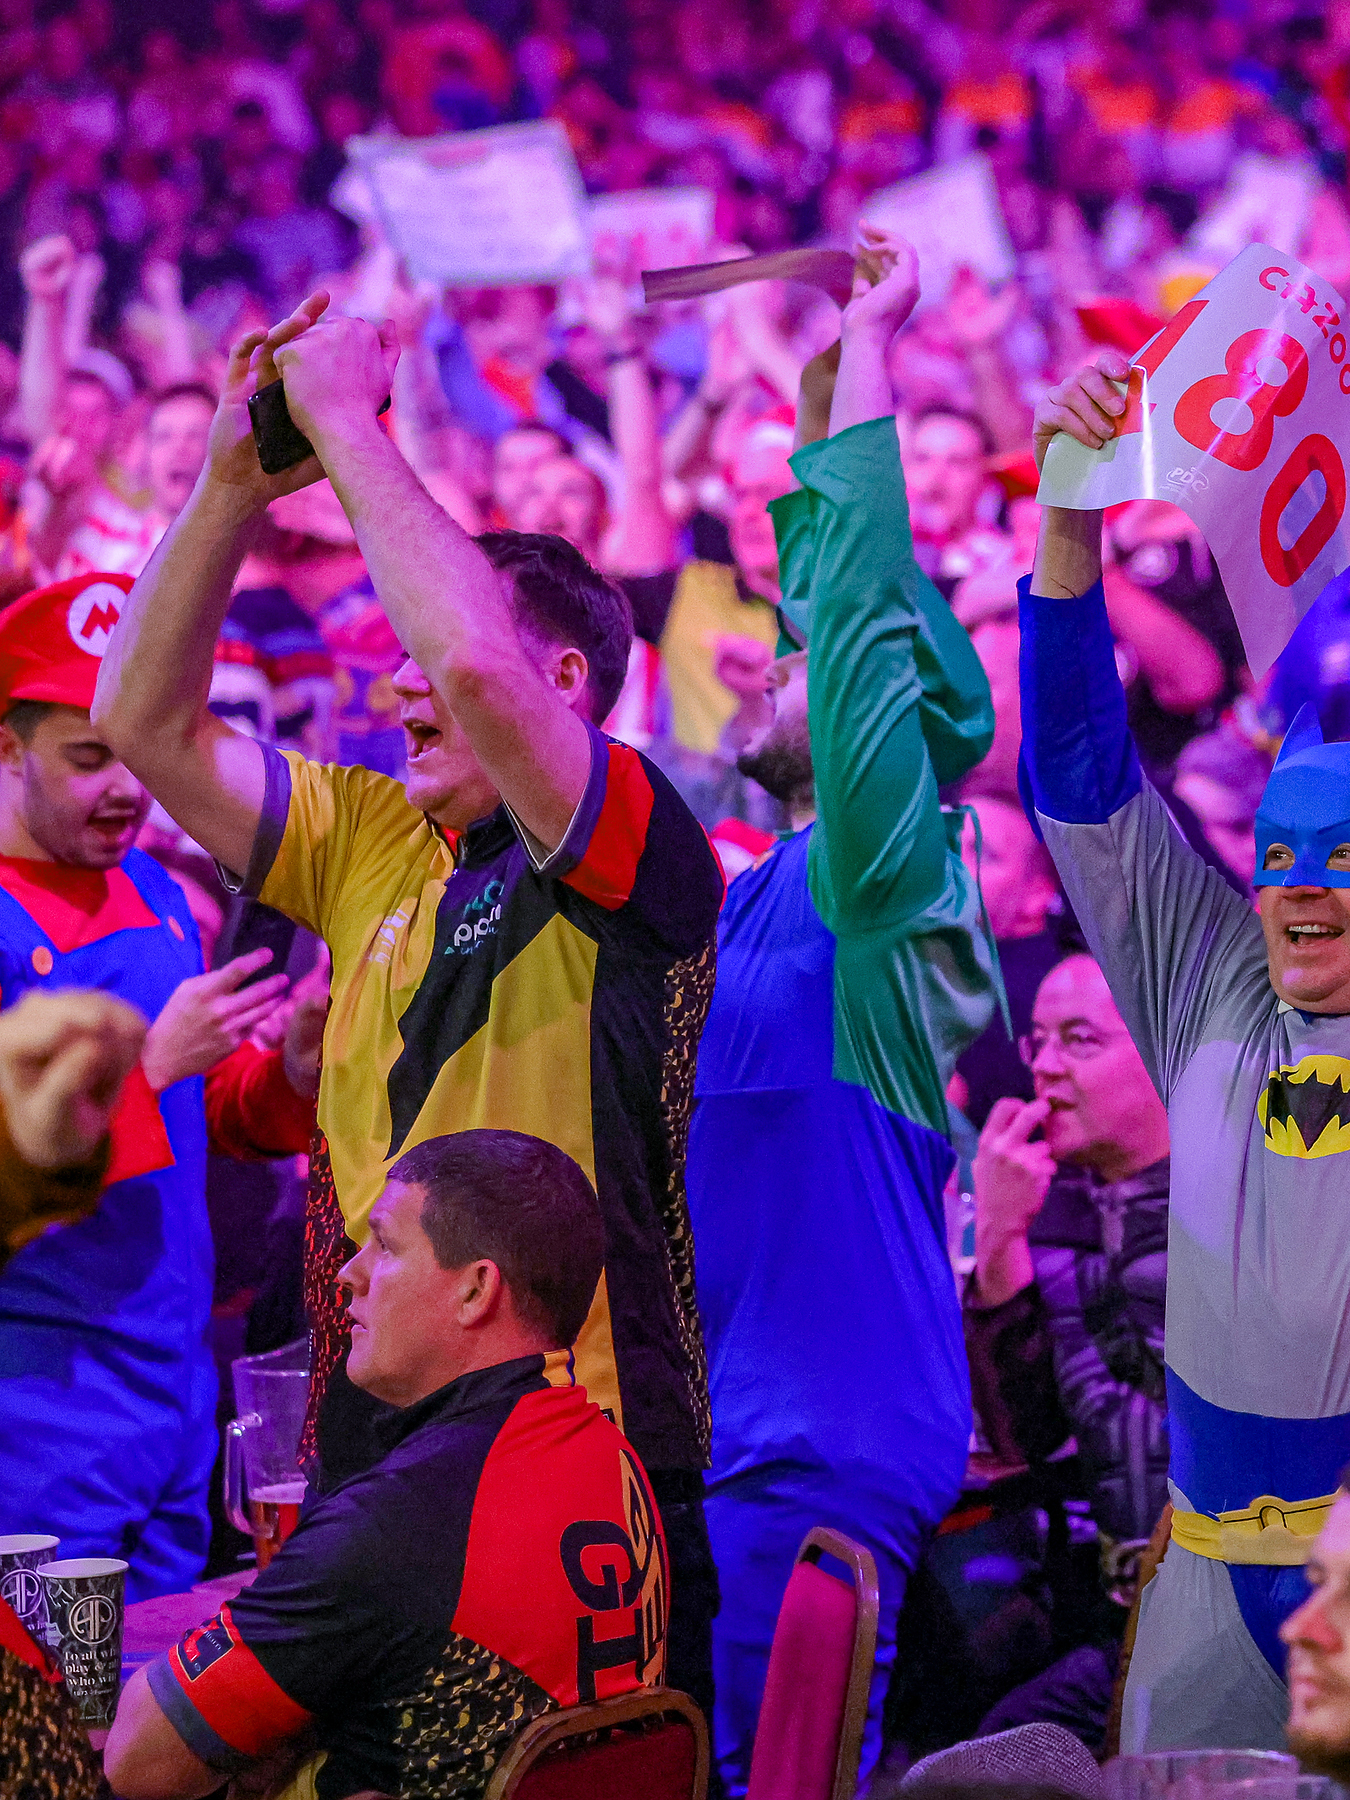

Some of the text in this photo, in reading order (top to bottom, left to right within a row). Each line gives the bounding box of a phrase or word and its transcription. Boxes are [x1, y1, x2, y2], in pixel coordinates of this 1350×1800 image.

[1113, 299, 1347, 588] 180
[1168, 466, 1208, 494] PDC
[80, 600, 120, 640] M
[65, 1662, 91, 1676] play
[68, 1676, 96, 1686] who
